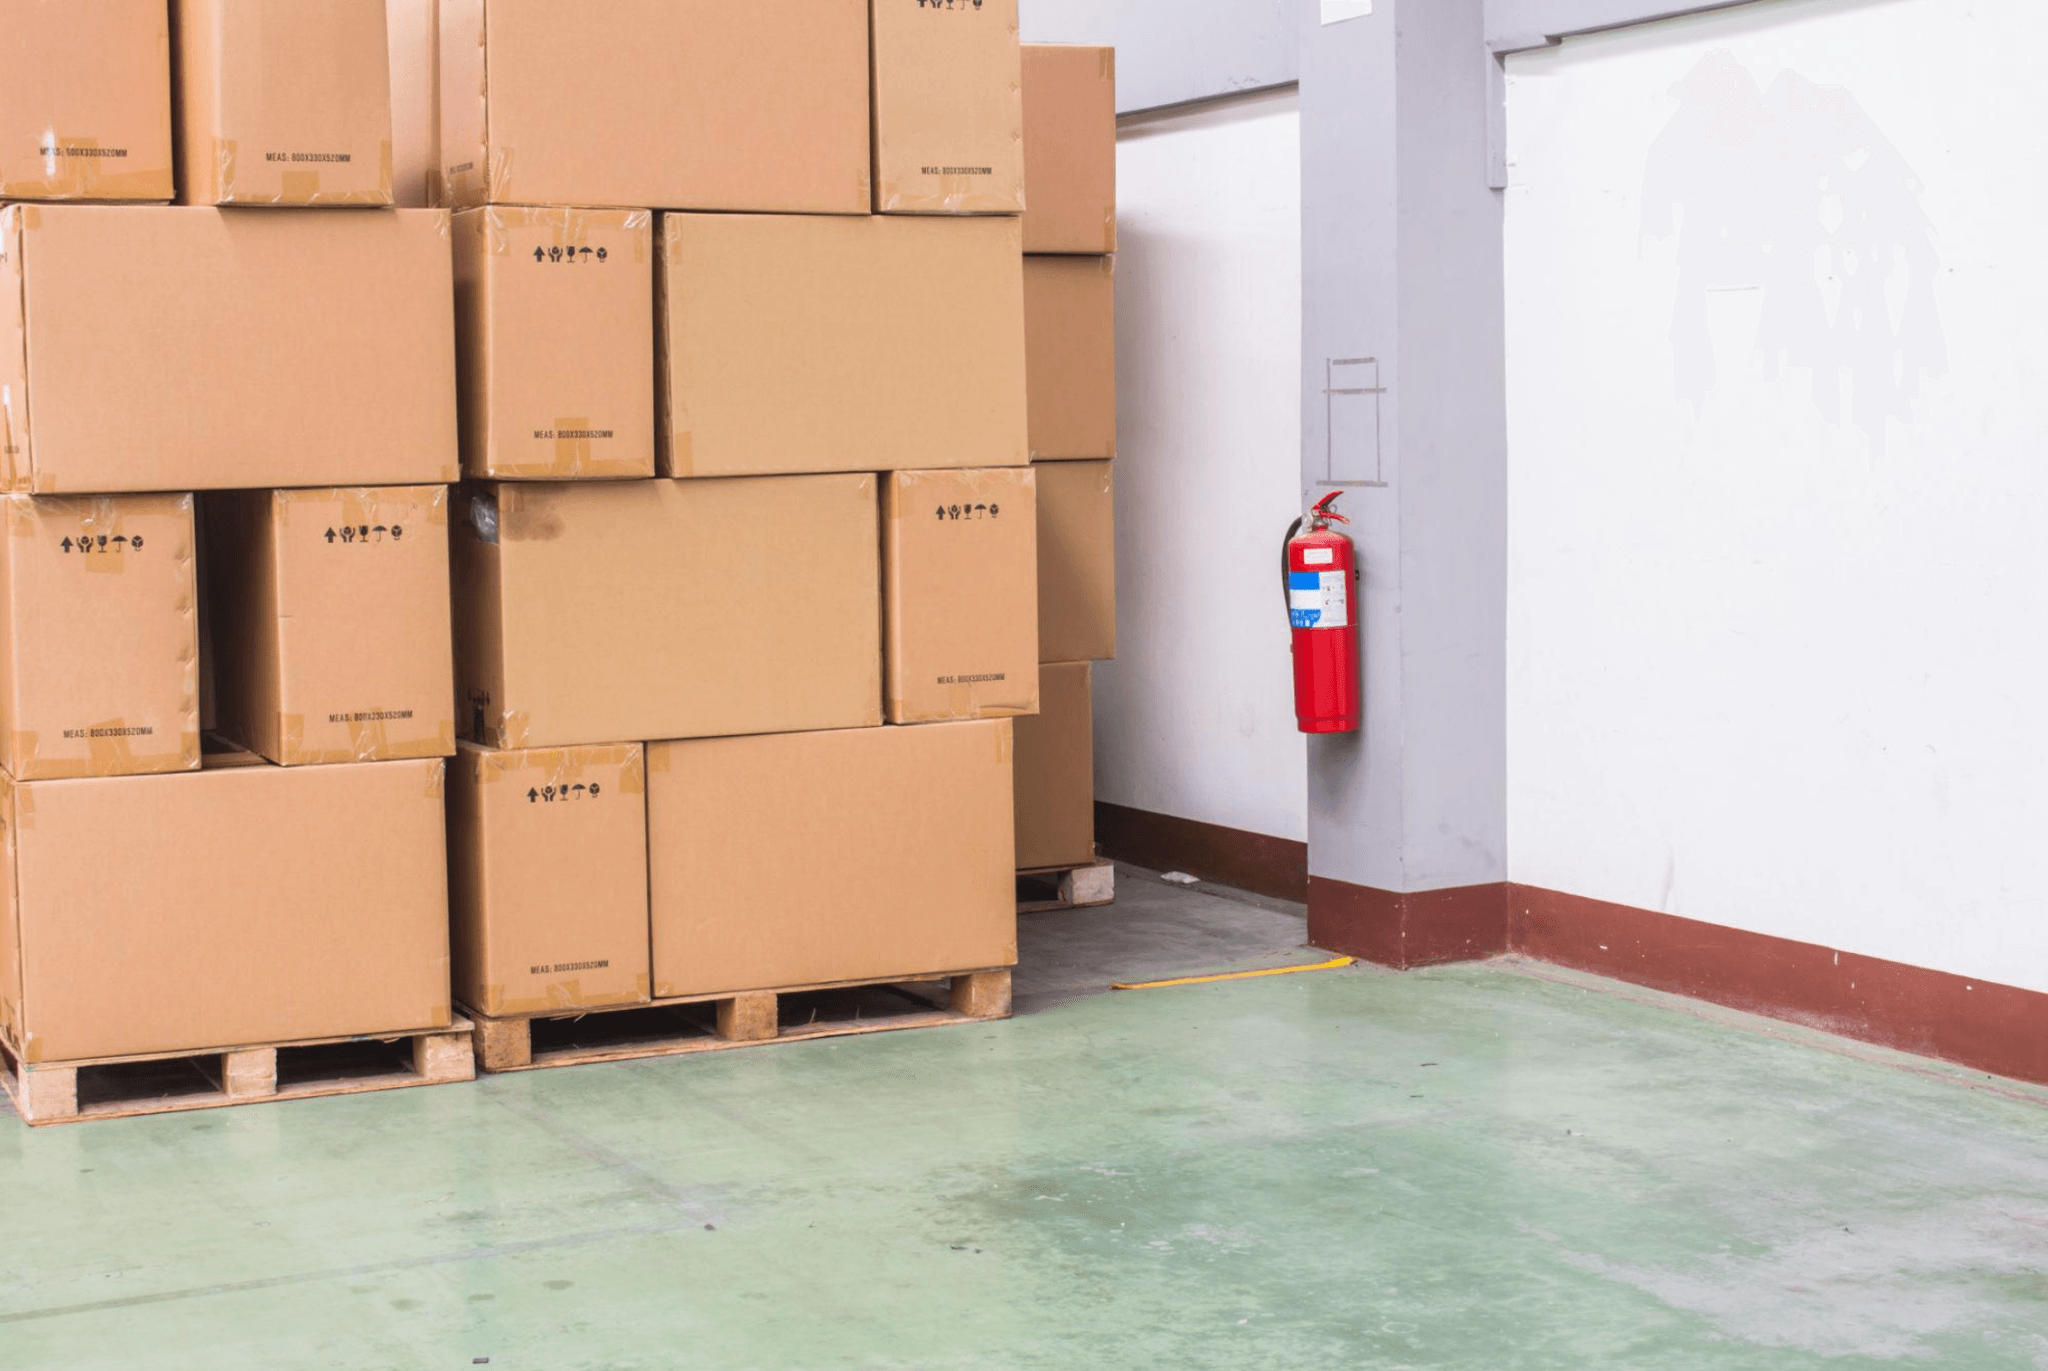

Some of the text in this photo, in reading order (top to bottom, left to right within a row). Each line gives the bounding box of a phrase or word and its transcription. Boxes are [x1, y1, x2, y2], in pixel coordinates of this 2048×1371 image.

[266, 152, 290, 162] MEAS:
[533, 430, 556, 439] MEAS:
[329, 714, 352, 723] MEAS:
[63, 727, 153, 738] MEAS: 800X330X520MM
[530, 964, 553, 974] MEAS:
